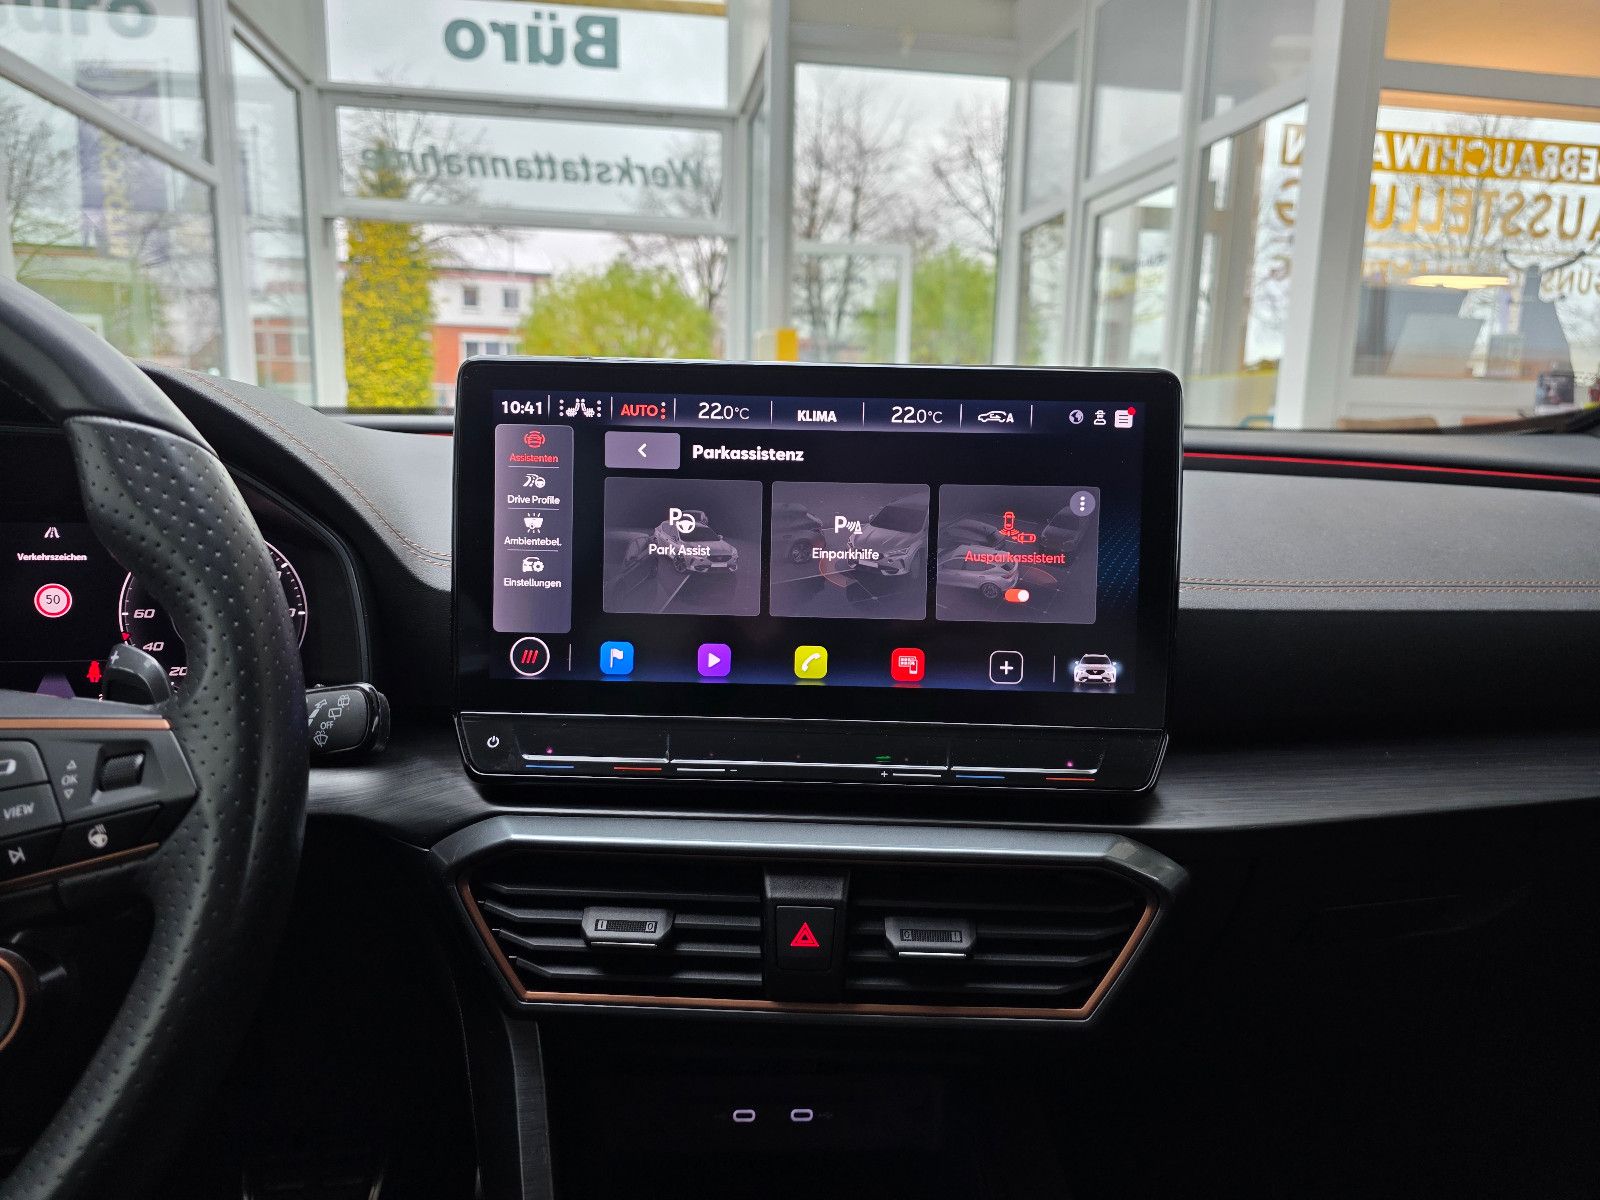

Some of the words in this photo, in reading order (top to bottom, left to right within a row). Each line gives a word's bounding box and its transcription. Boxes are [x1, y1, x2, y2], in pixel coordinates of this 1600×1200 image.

[501, 400, 543, 415] 10:41
[620, 404, 659, 418] AUTO
[797, 409, 837, 423] KLIMA
[509, 452, 559, 464] Assistenten
[692, 444, 804, 463] Parkassistenz
[507, 494, 530, 505] Drive
[532, 494, 561, 506] Profile
[504, 536, 562, 547] Ambientebel.
[649, 543, 676, 556] Park
[678, 545, 711, 557] Assist
[812, 547, 880, 563] Einparkhilfe
[16, 552, 88, 562] Verkehrszeichen
[964, 550, 1066, 565] Ausparkassistent
[503, 577, 562, 589] Einstellungen
[45, 594, 61, 605] 50
[133, 608, 155, 619] 60
[142, 641, 165, 652] 40
[168, 666, 188, 677] 20
[319, 721, 335, 731] OFF
[61, 774, 79, 786] OK
[2, 801, 35, 820] VIEW
